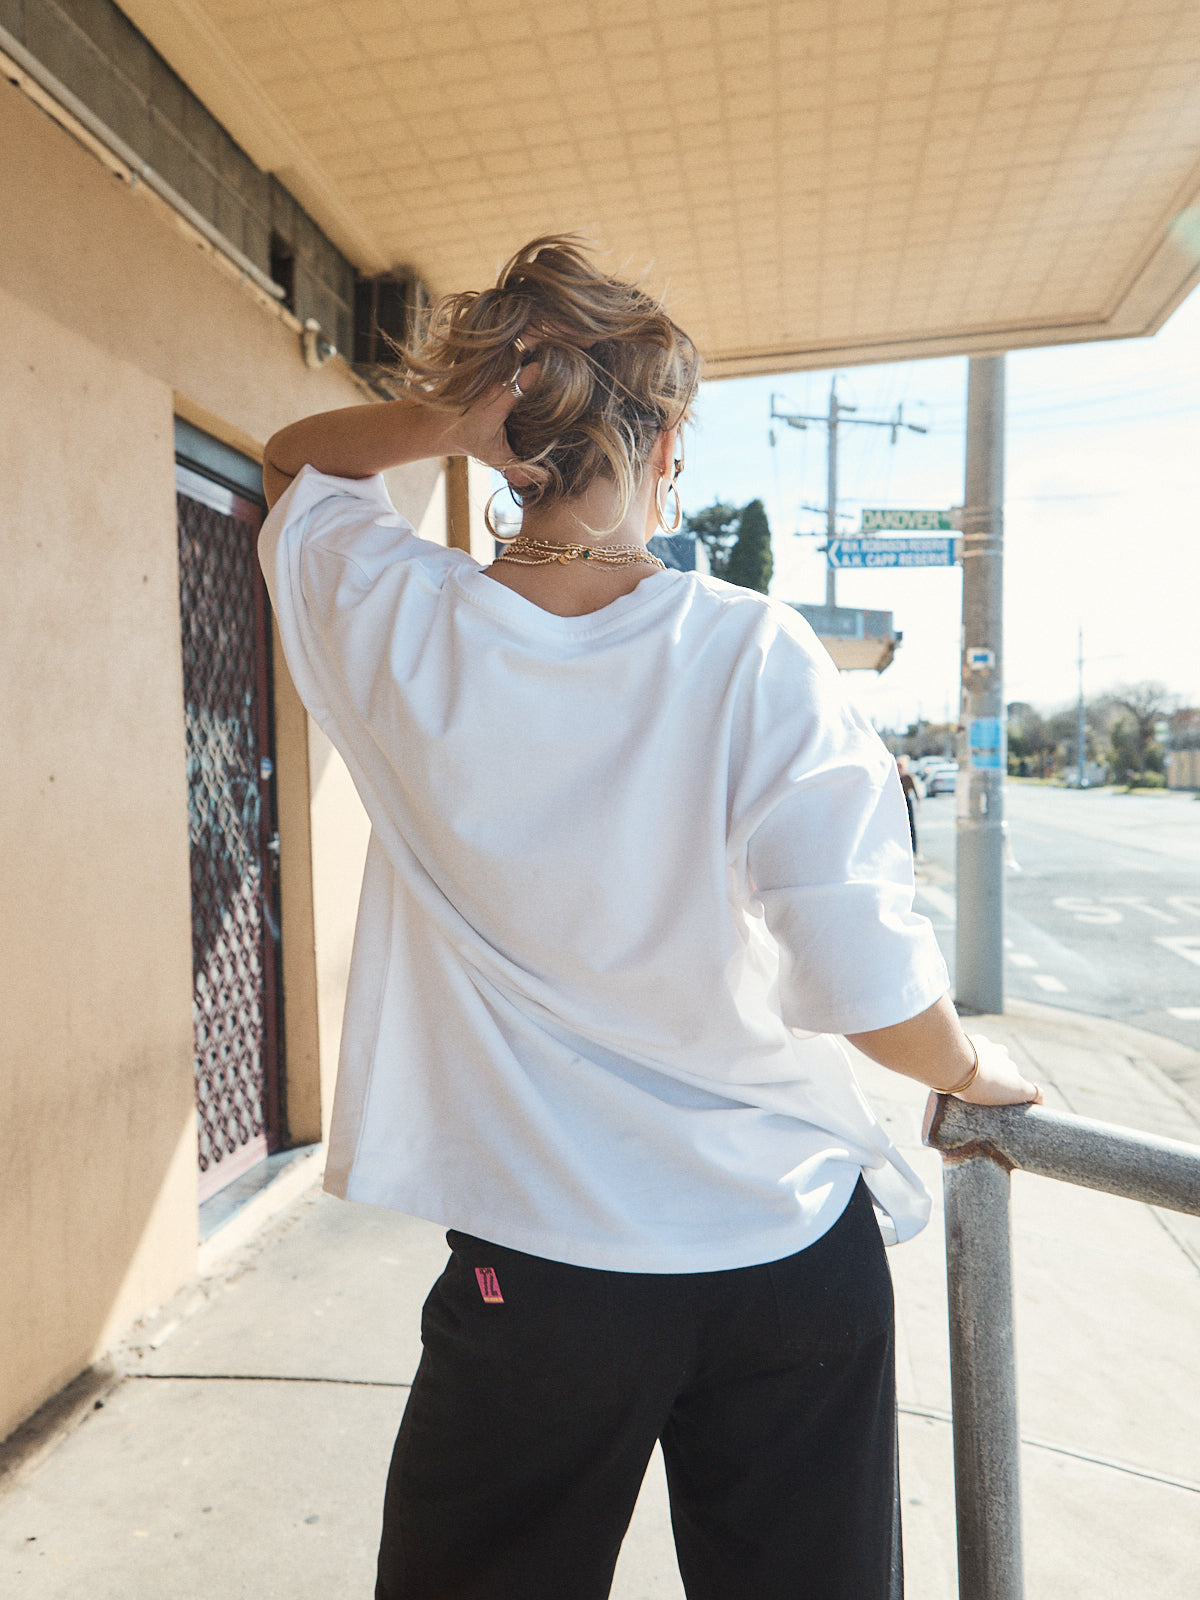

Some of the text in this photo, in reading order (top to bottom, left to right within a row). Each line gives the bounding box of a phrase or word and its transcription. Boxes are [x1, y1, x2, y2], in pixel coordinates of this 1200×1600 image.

[863, 511, 939, 529] OAKOVER
[865, 554, 897, 566] CAPP
[898, 553, 949, 565] RESERVE
